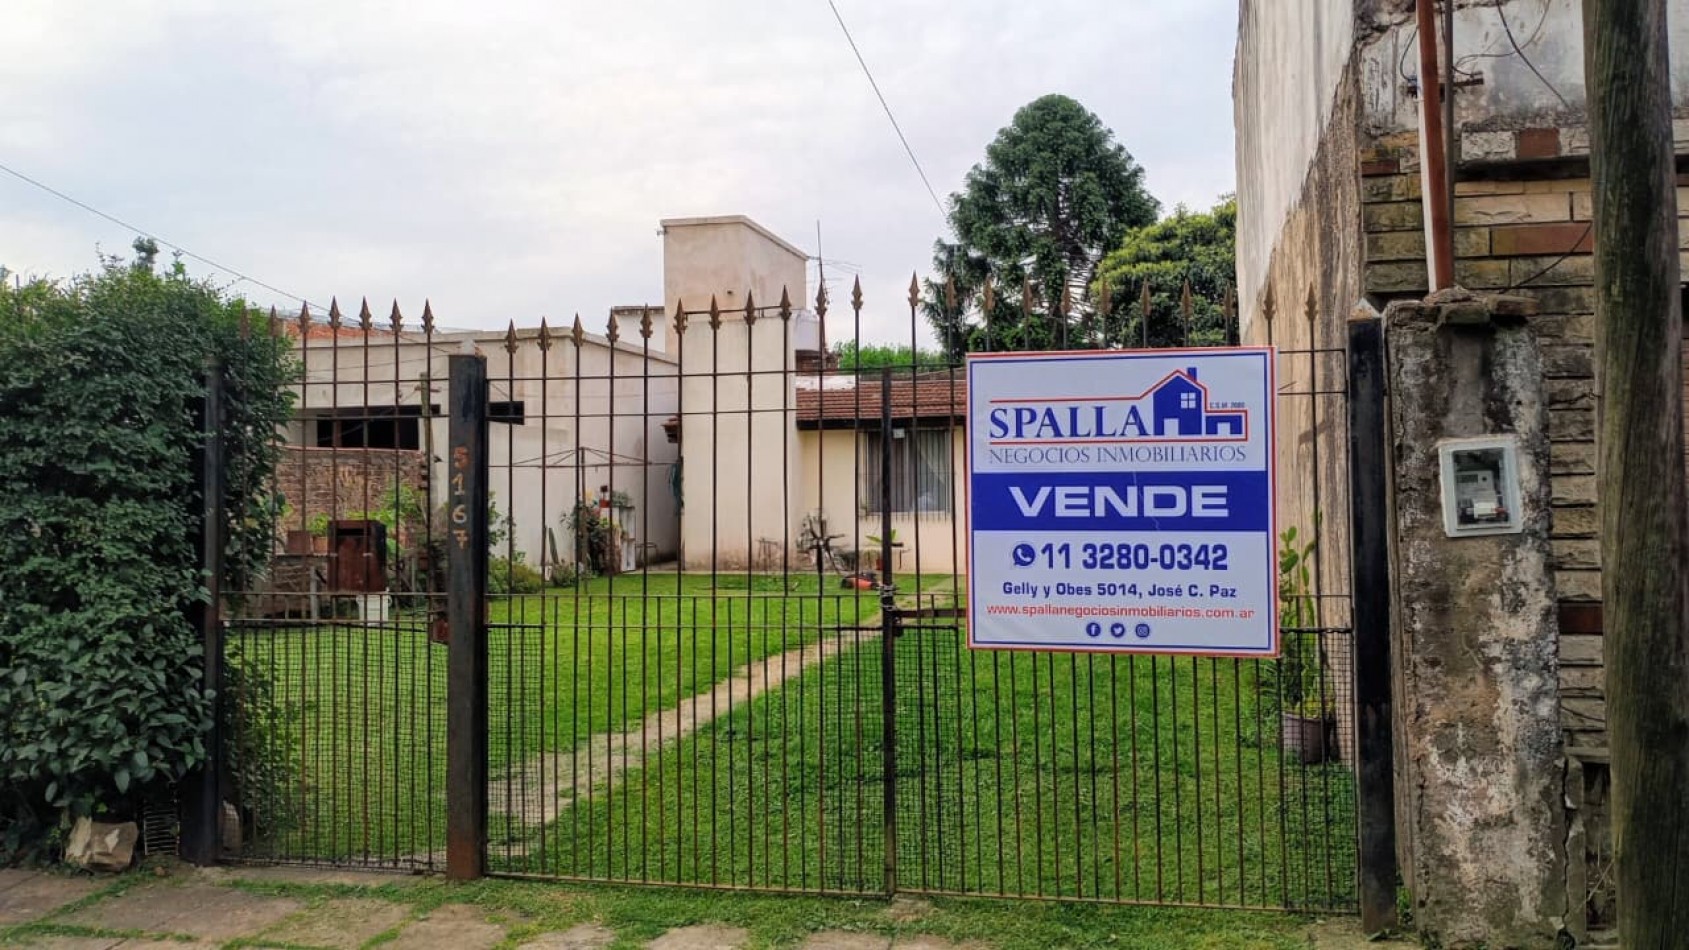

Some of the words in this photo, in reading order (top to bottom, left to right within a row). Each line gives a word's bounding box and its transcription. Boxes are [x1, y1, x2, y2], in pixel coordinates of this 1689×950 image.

[990, 405, 1150, 438] SPALLA
[990, 447, 1089, 464] NEGOCIOS
[1097, 446, 1246, 463] INMOBILIARIOS
[452, 446, 469, 550] 5167
[1009, 485, 1229, 517] VENDE
[1041, 543, 1071, 569] 11
[1082, 543, 1228, 570] 3280-0342
[1003, 582, 1038, 598] Gelly
[1044, 587, 1051, 599] y
[1056, 582, 1092, 596] Obes
[1097, 583, 1142, 598] 5014,
[1148, 583, 1183, 597] José
[1188, 585, 1203, 597] C.
[1209, 585, 1237, 598] Paz
[987, 604, 1255, 619] www.spallanegociosinmobiliarios.com.ar
